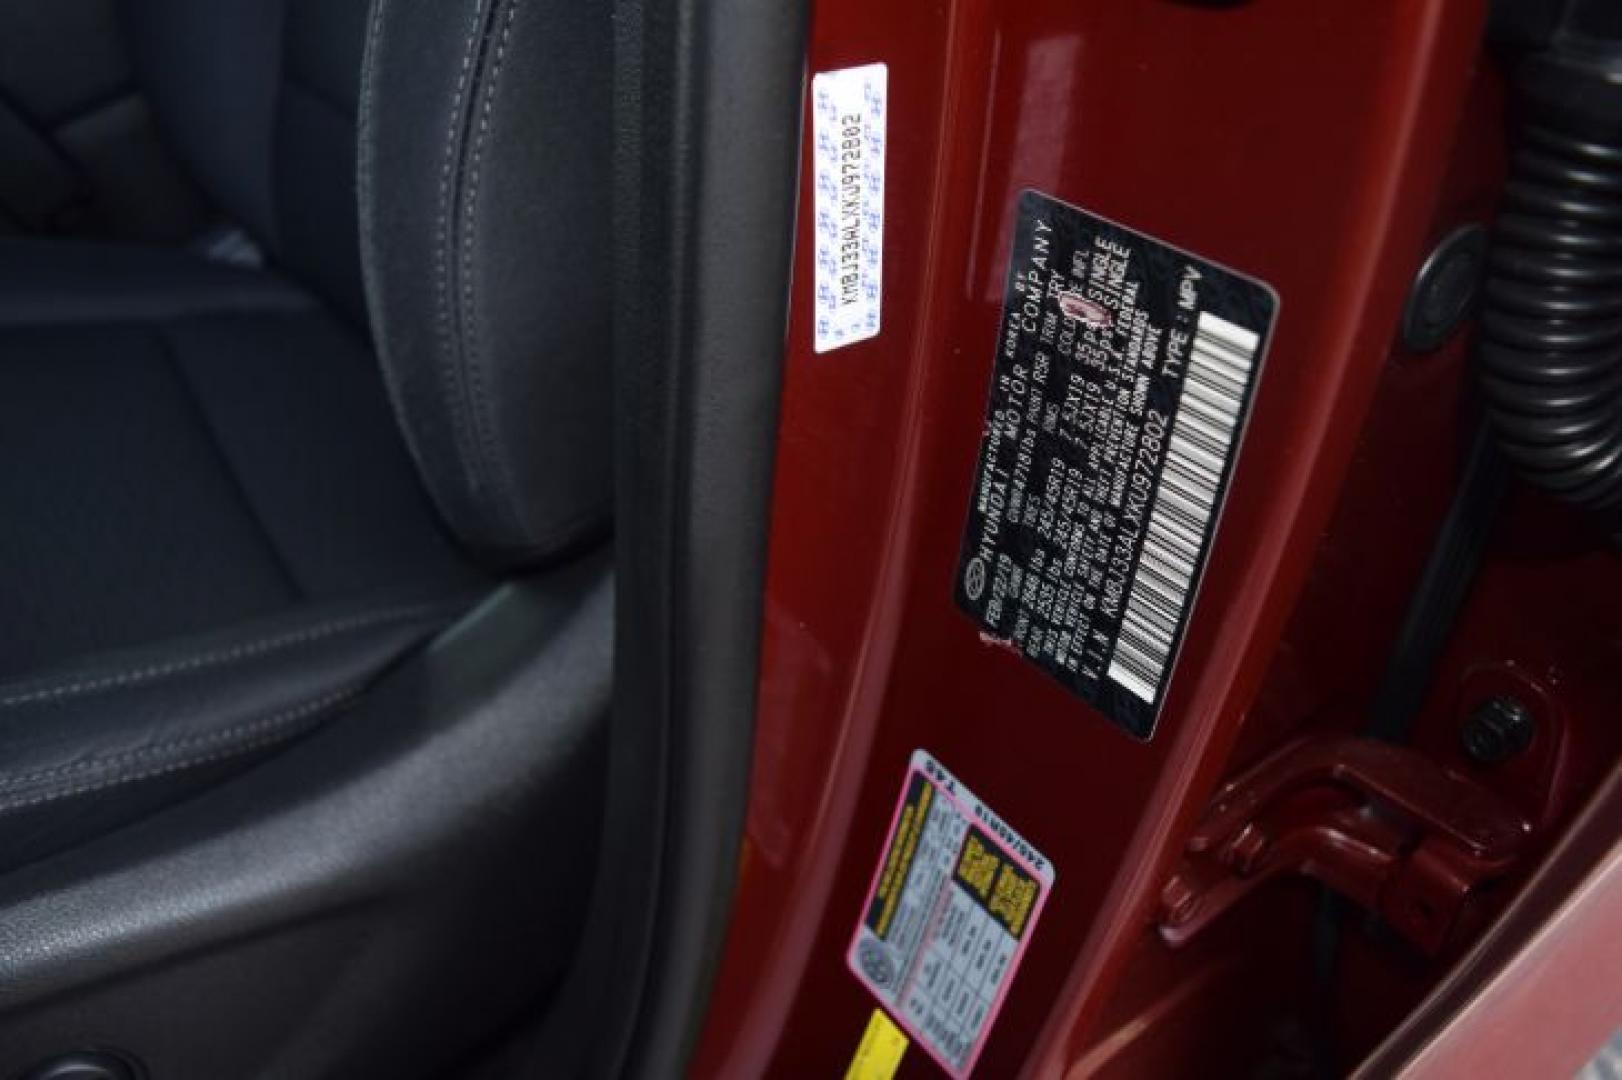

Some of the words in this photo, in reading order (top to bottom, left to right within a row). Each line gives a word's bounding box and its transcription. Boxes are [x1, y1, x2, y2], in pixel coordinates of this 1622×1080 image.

[841, 113, 861, 305] KM8J33ALXKU972802
[1046, 268, 1065, 303] TRY
[1084, 234, 1114, 302] SINGLE
[1101, 241, 1132, 311] SINGLE
[1039, 308, 1058, 345] TRIM
[1114, 275, 1140, 337] FEDERAL
[1003, 309, 1021, 358] KOREA
[1119, 307, 1149, 383] STANDARDS
[1139, 322, 1162, 369] ABOVE
[978, 465, 1008, 565] HYUNDAI
[1001, 361, 1029, 442] MOTOR
[1018, 218, 1054, 335] COMPANY
[998, 372, 1010, 392] IN
[1128, 371, 1151, 417] SHOWN
[1086, 394, 1114, 471] APPLICABLE
[1098, 407, 1169, 620] KM8J33ALXKU972802
[1159, 327, 1189, 381] TYPE
[1175, 262, 1204, 312] MPV
[1102, 385, 1132, 465] PREVENTION
[1080, 472, 1096, 498] ALL
[1093, 467, 1113, 506] THEFT
[1107, 420, 1139, 508] MANUFACTURE
[1036, 454, 1066, 540] 245/45R19
[1051, 463, 1083, 550] 245/45R19
[1075, 498, 1089, 518] TO
[1087, 506, 1104, 534] AND
[1101, 509, 1117, 529] OF
[1029, 545, 1046, 574] lbs
[1044, 553, 1063, 584] lbs
[1062, 519, 1084, 576] CONFORMS
[1075, 532, 1097, 578] SAFETY
[1093, 531, 1112, 564] DATE
[985, 549, 1011, 629] FEB/22/19
[1087, 564, 1103, 590] THE
[1049, 577, 1071, 628] VEHICLE
[1063, 580, 1085, 629] VEHICLE
[1082, 591, 1097, 612] ON
[1070, 610, 1091, 657] EFFECT
